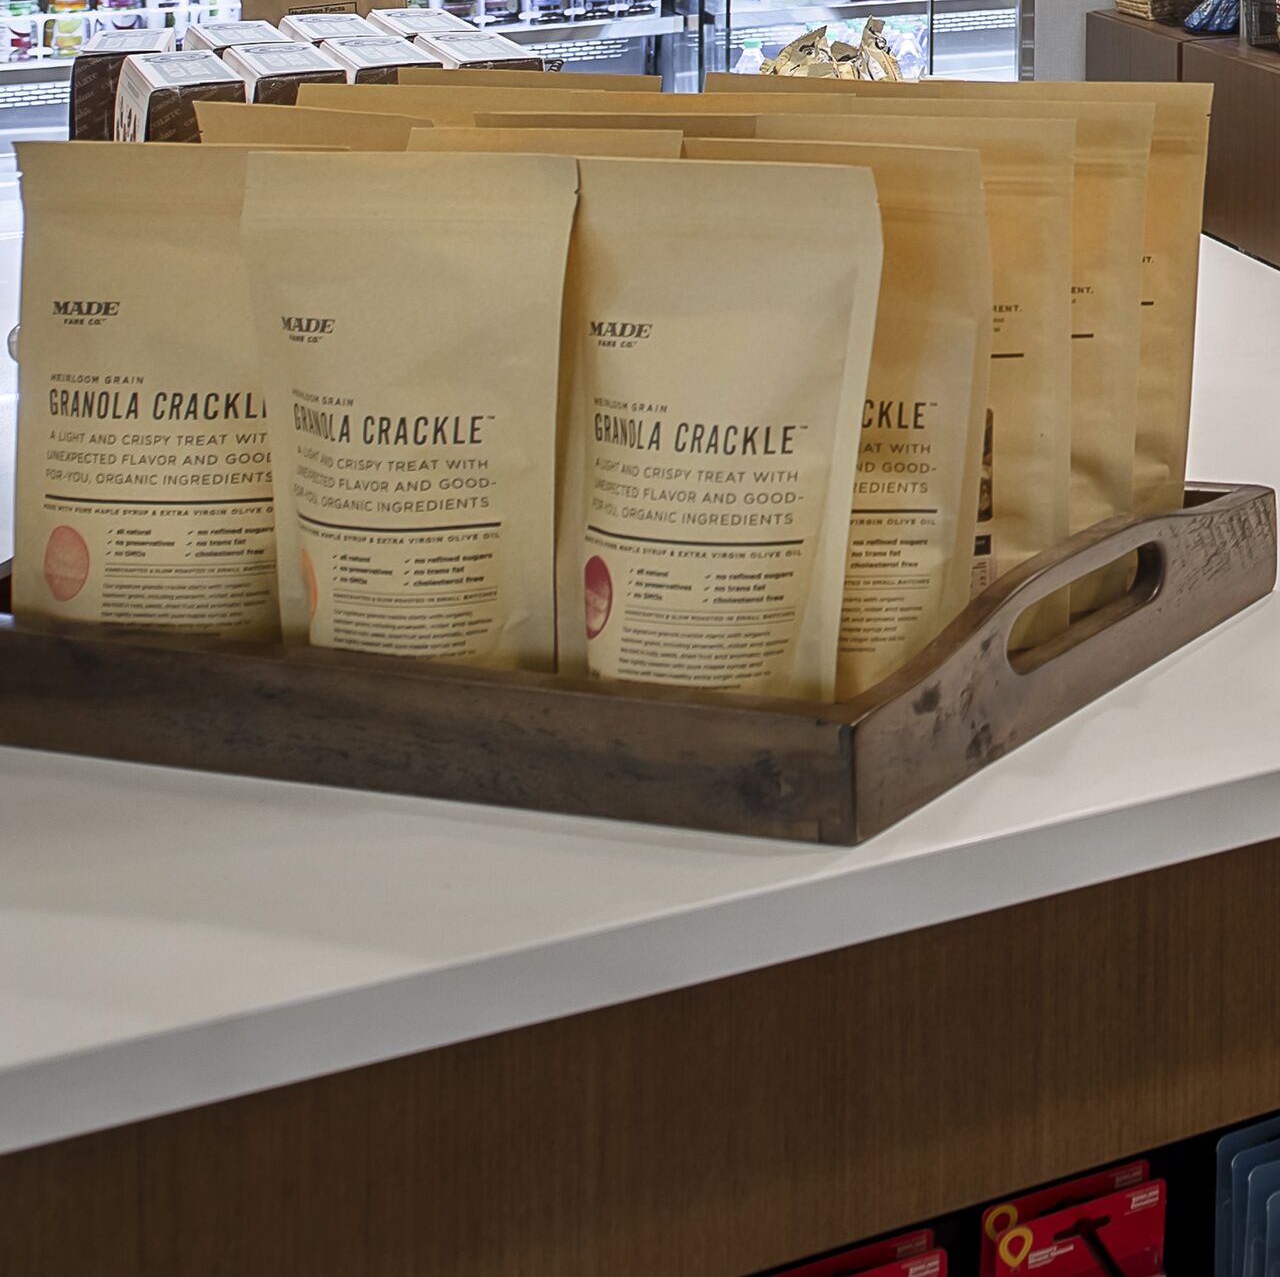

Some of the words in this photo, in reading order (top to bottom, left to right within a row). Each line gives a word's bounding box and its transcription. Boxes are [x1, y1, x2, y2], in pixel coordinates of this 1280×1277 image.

[52, 301, 120, 316] MADE
[282, 316, 336, 334] MADE
[589, 321, 653, 339] MADE
[51, 374, 99, 384] HEIRLOOM
[105, 376, 144, 384] GRAIN
[50, 388, 139, 419] GRANOLA
[322, 396, 354, 407] GRAIN
[631, 402, 668, 413] GRAIN
[294, 403, 351, 443] GRANOLA
[50, 430, 55, 441] A
[58, 431, 85, 443] LIGHT
[89, 434, 117, 445] AND
[121, 434, 171, 446] CRISPY
[177, 434, 228, 446] TREAT
[595, 413, 661, 451] GRANOLA
[890, 443, 931, 454] WITH
[46, 450, 117, 465] UNEXPECTED
[121, 453, 177, 466] FLAVOR
[182, 453, 218, 466] AND
[337, 458, 382, 471] CRISPY
[388, 460, 438, 472] TREAT
[446, 460, 488, 470] WITH
[643, 467, 693, 481] CRISPY
[697, 471, 746, 483] TREAT
[753, 471, 798, 482] WITH
[882, 462, 937, 474] GOOD-
[96, 474, 157, 486] ORGANIC
[162, 471, 273, 486] INGREDIENTS
[339, 478, 389, 492] FLAVOR
[395, 479, 432, 492] AND
[439, 478, 497, 490] GOOD-
[321, 496, 373, 511] ORGANIC
[377, 496, 489, 513] INGREDIENTS
[643, 488, 696, 503] FLAVOR
[703, 492, 737, 504] AND
[743, 492, 804, 505] GOOD-
[621, 507, 677, 523] ORGANIC
[682, 513, 793, 526] INGREDIENTS
